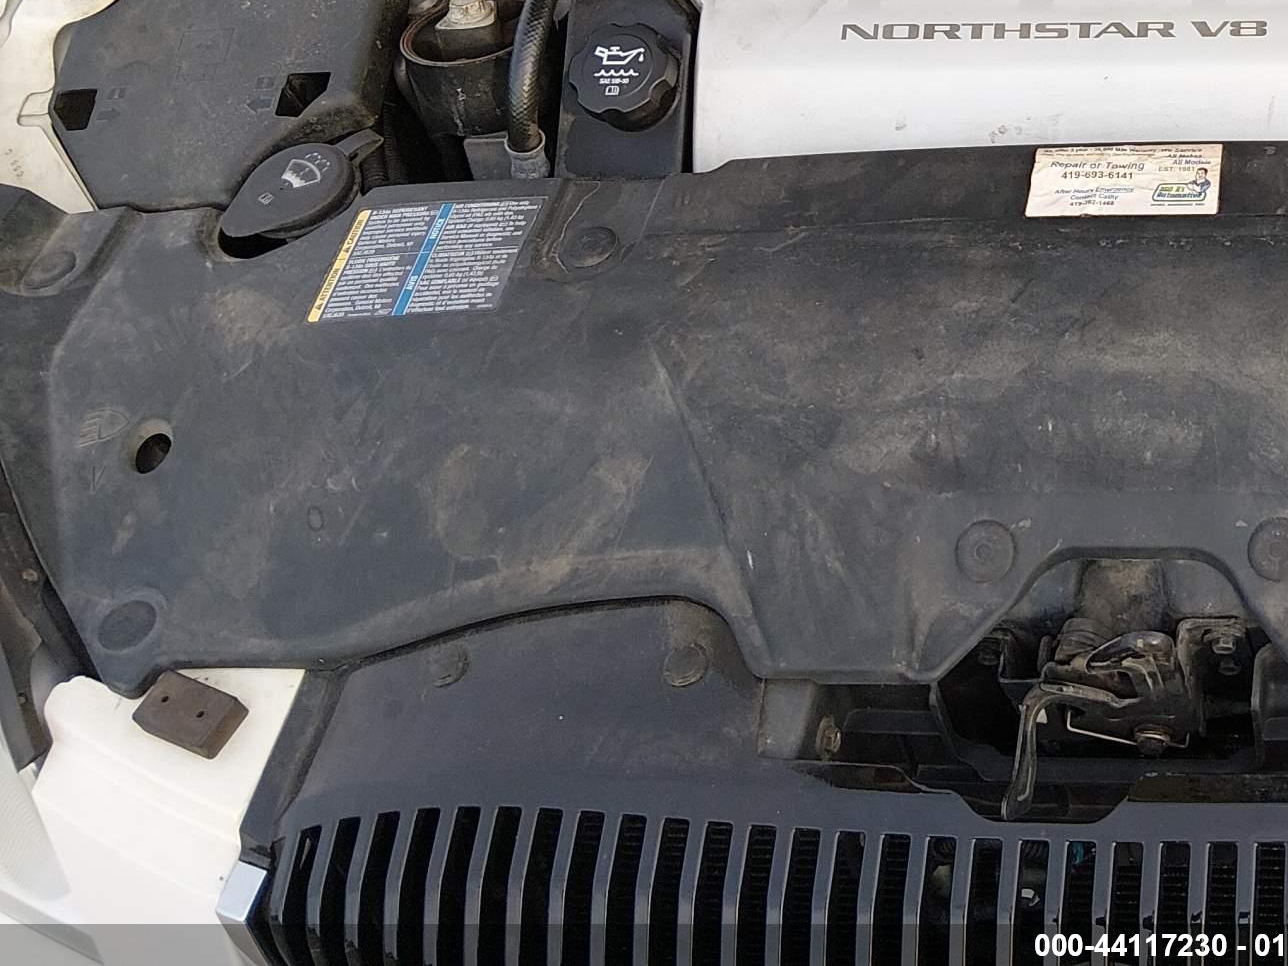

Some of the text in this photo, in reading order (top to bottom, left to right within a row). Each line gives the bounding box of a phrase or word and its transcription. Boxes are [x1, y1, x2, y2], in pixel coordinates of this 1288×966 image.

[841, 20, 1268, 41] NORTHSTAR V8
[1051, 161, 1087, 169] Repair
[1106, 161, 1145, 171] Towing
[1061, 171, 1133, 179] 419-693-6141
[347, 218, 364, 244] CAUTION
[431, 218, 446, 239] NOTICE
[320, 267, 341, 301] ATTENTION
[405, 274, 418, 291] AVIS
